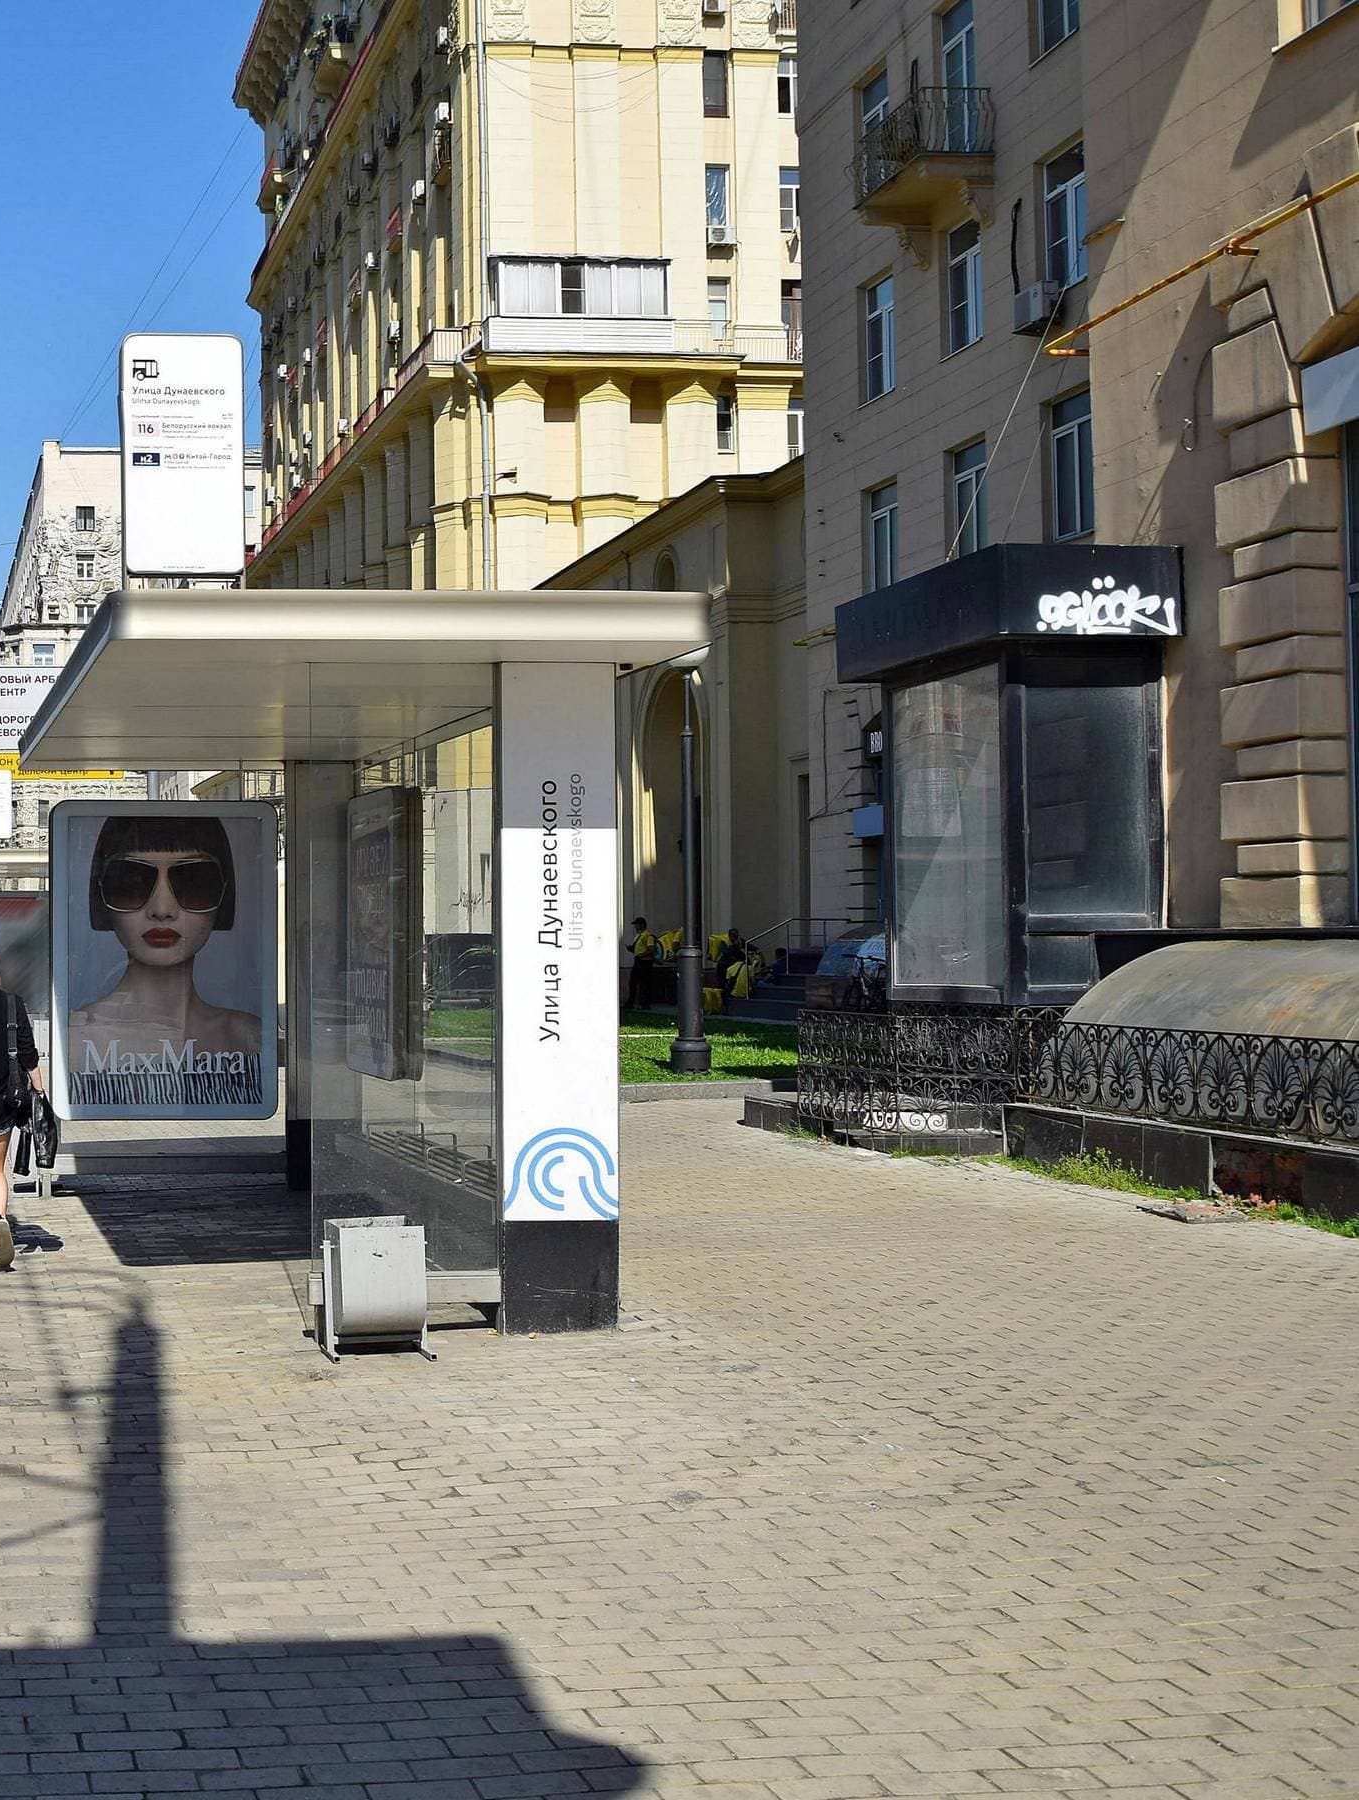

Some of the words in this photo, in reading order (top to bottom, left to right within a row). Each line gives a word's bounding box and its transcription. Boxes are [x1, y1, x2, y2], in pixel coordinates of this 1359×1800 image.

[132, 386, 161, 396] Улица
[164, 386, 225, 396] Дунаевского
[137, 423, 155, 434] 116
[161, 422, 206, 430] Белорусский
[34, 675, 59, 684] АРБ
[567, 773, 586, 895] Dunaevskogo
[538, 780, 563, 948] Дунаевского
[568, 901, 583, 950] Ulitsa
[539, 963, 561, 1042] Улица
[81, 1038, 247, 1076] MaxMara
